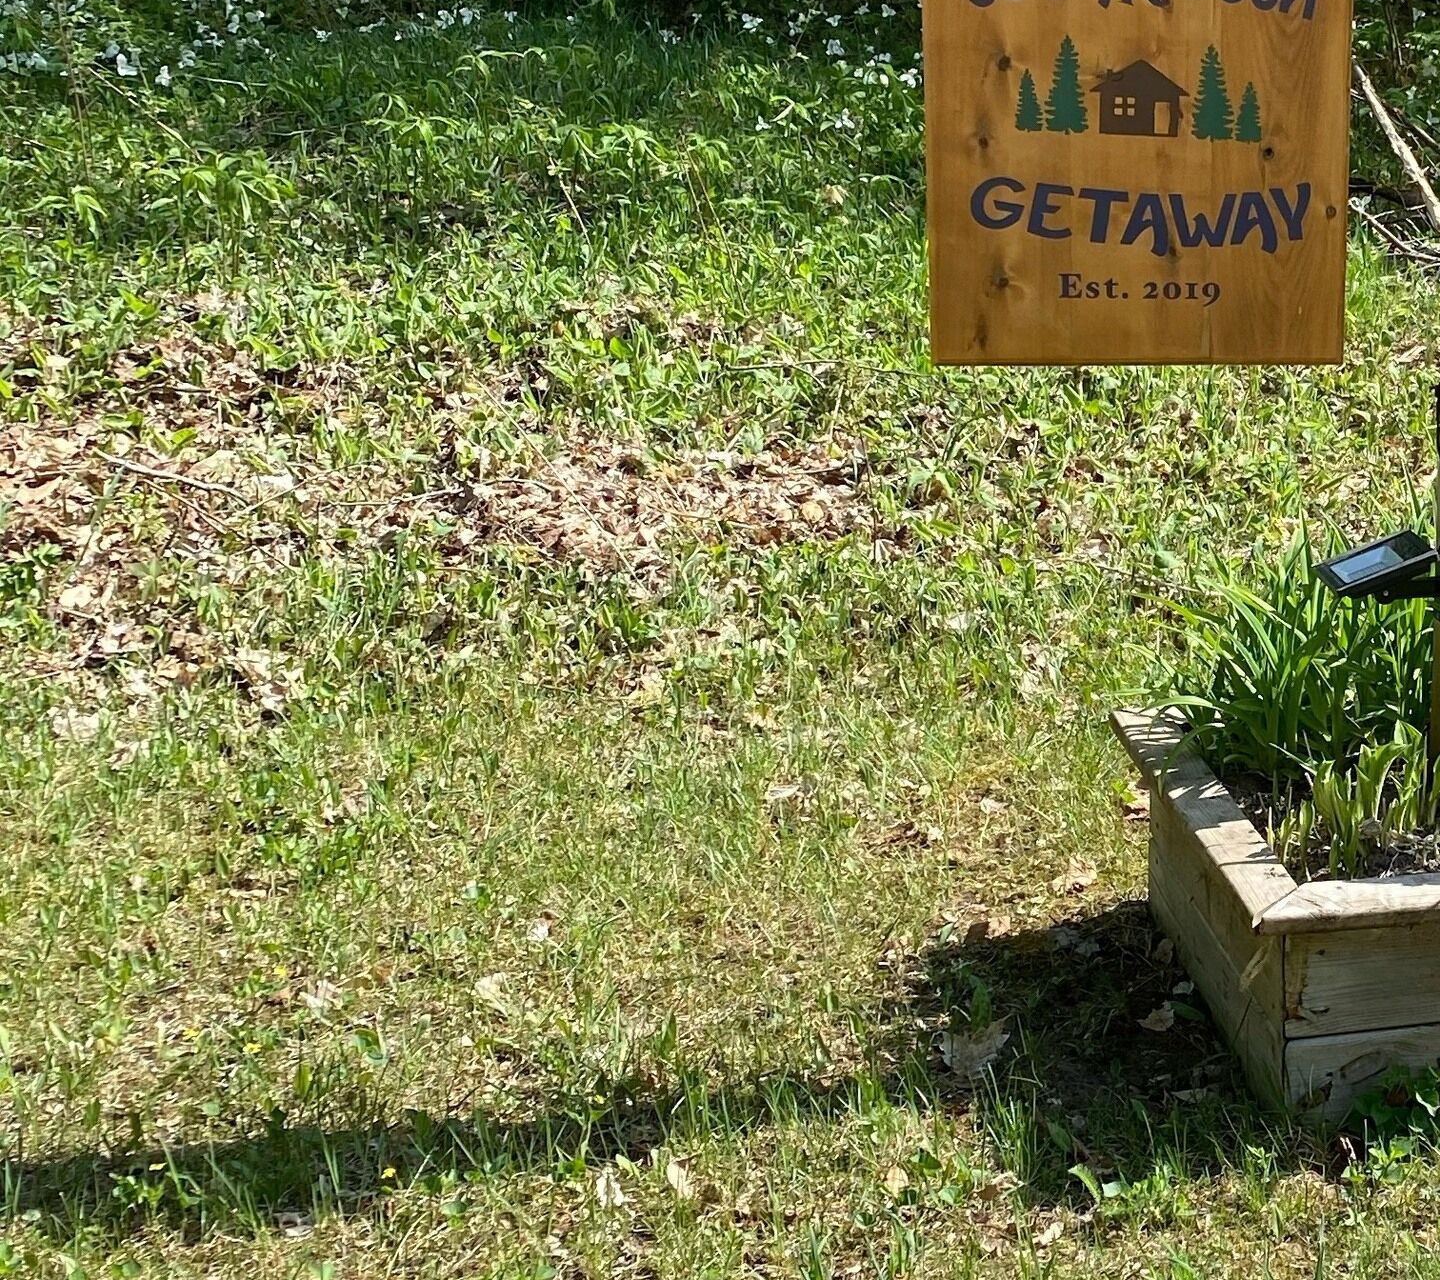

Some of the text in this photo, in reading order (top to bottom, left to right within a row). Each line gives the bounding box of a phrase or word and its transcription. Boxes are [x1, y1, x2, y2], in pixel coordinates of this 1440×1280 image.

[970, 176, 1312, 257] GETAWAY
[1058, 273, 1221, 307] Est. 2019
